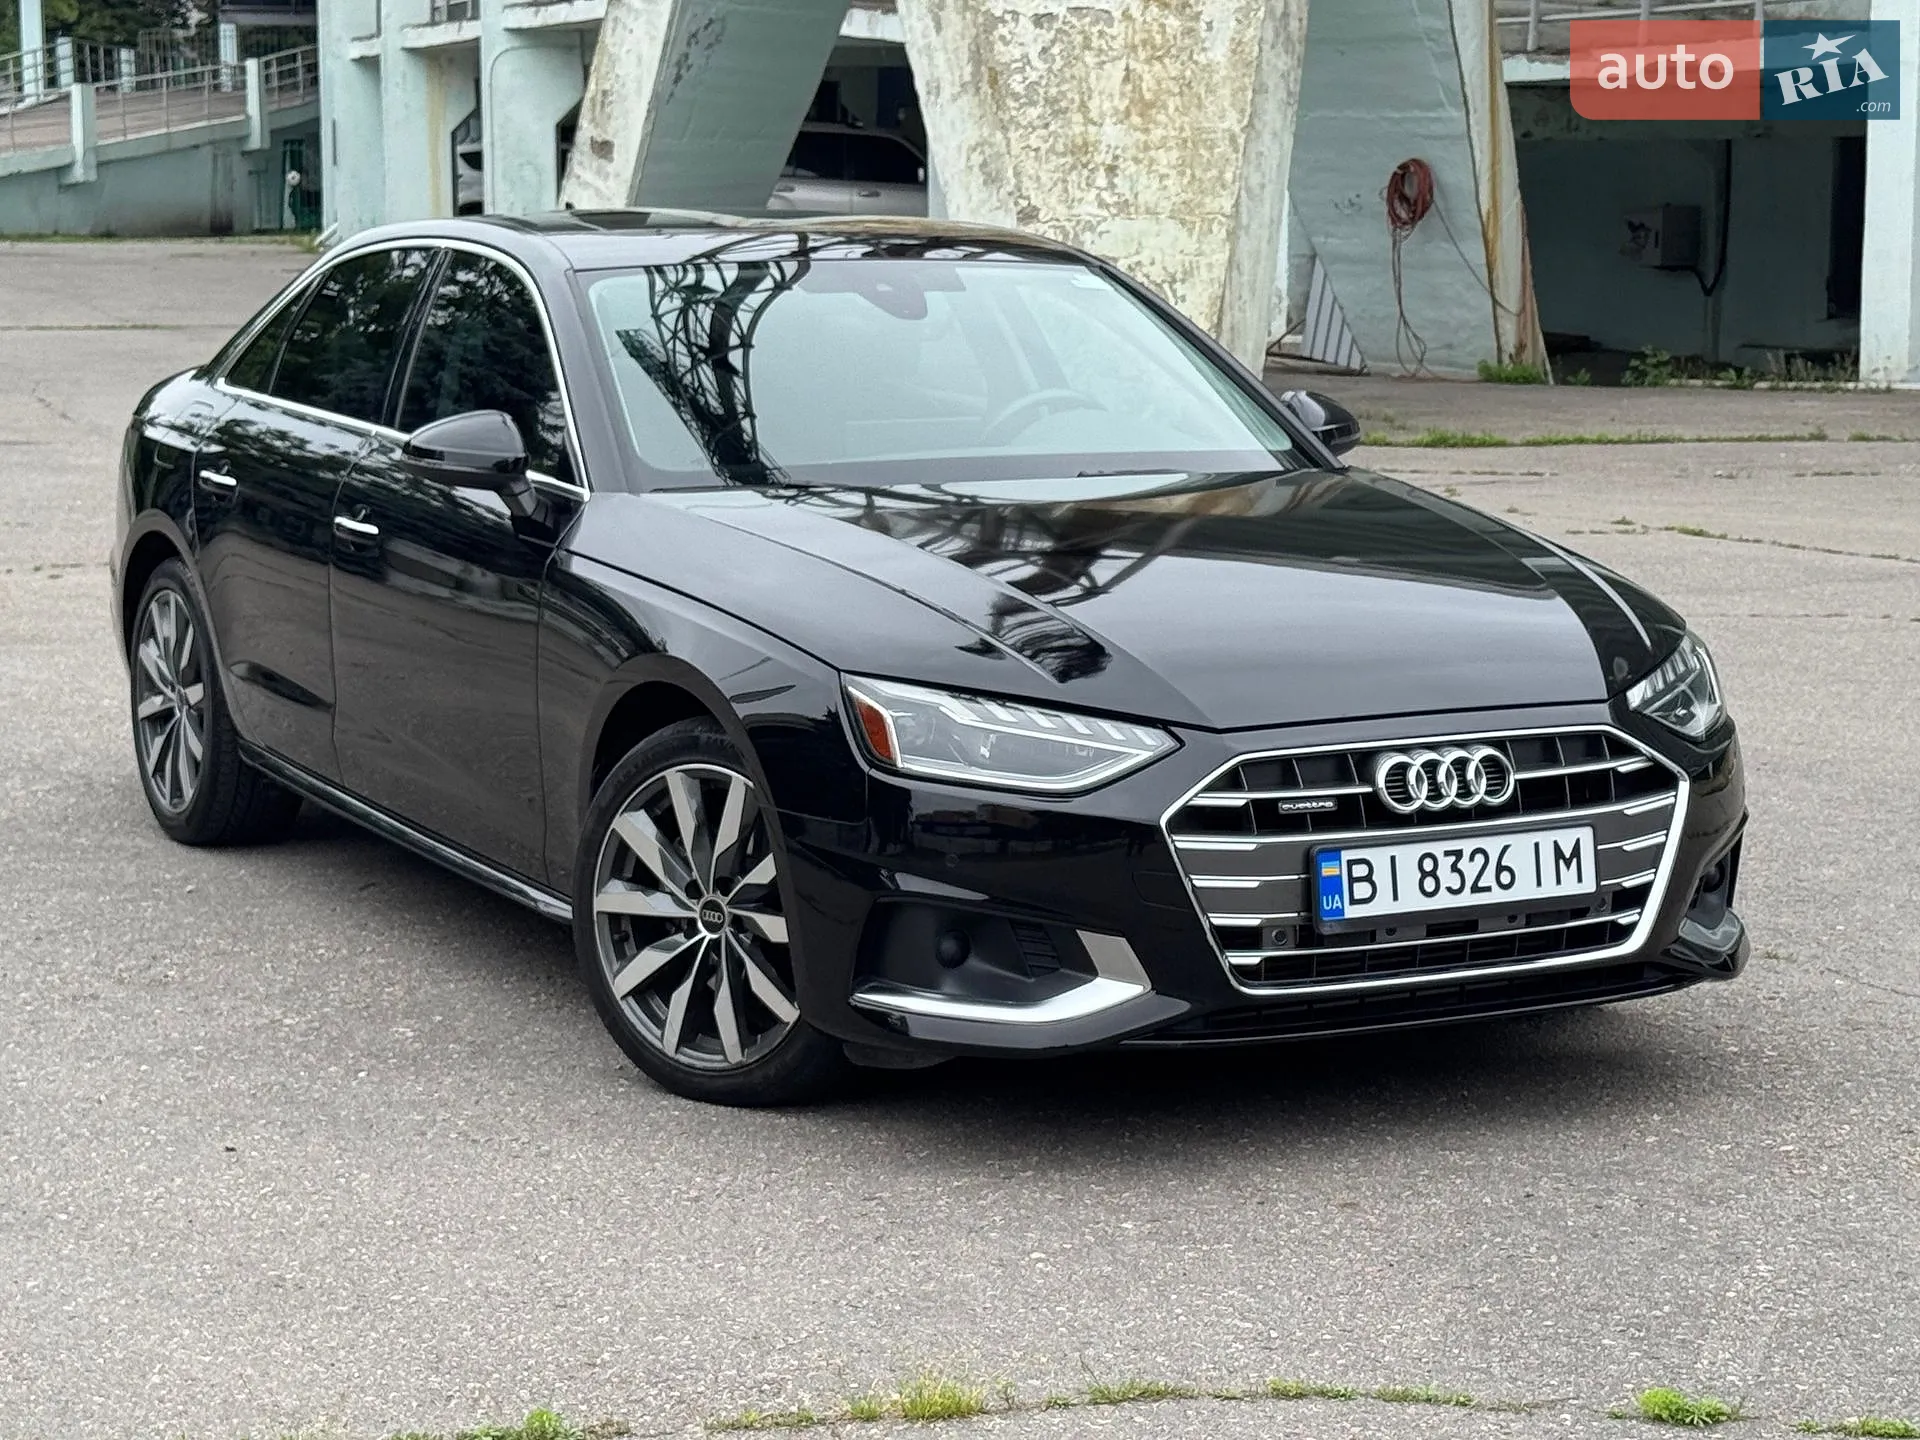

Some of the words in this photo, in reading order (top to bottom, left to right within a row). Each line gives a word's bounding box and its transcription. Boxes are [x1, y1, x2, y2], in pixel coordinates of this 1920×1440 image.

[1346, 855, 1399, 906] BI
[1417, 844, 1516, 898] 8326
[1533, 836, 1583, 888] IM
[1323, 895, 1342, 910] UA
